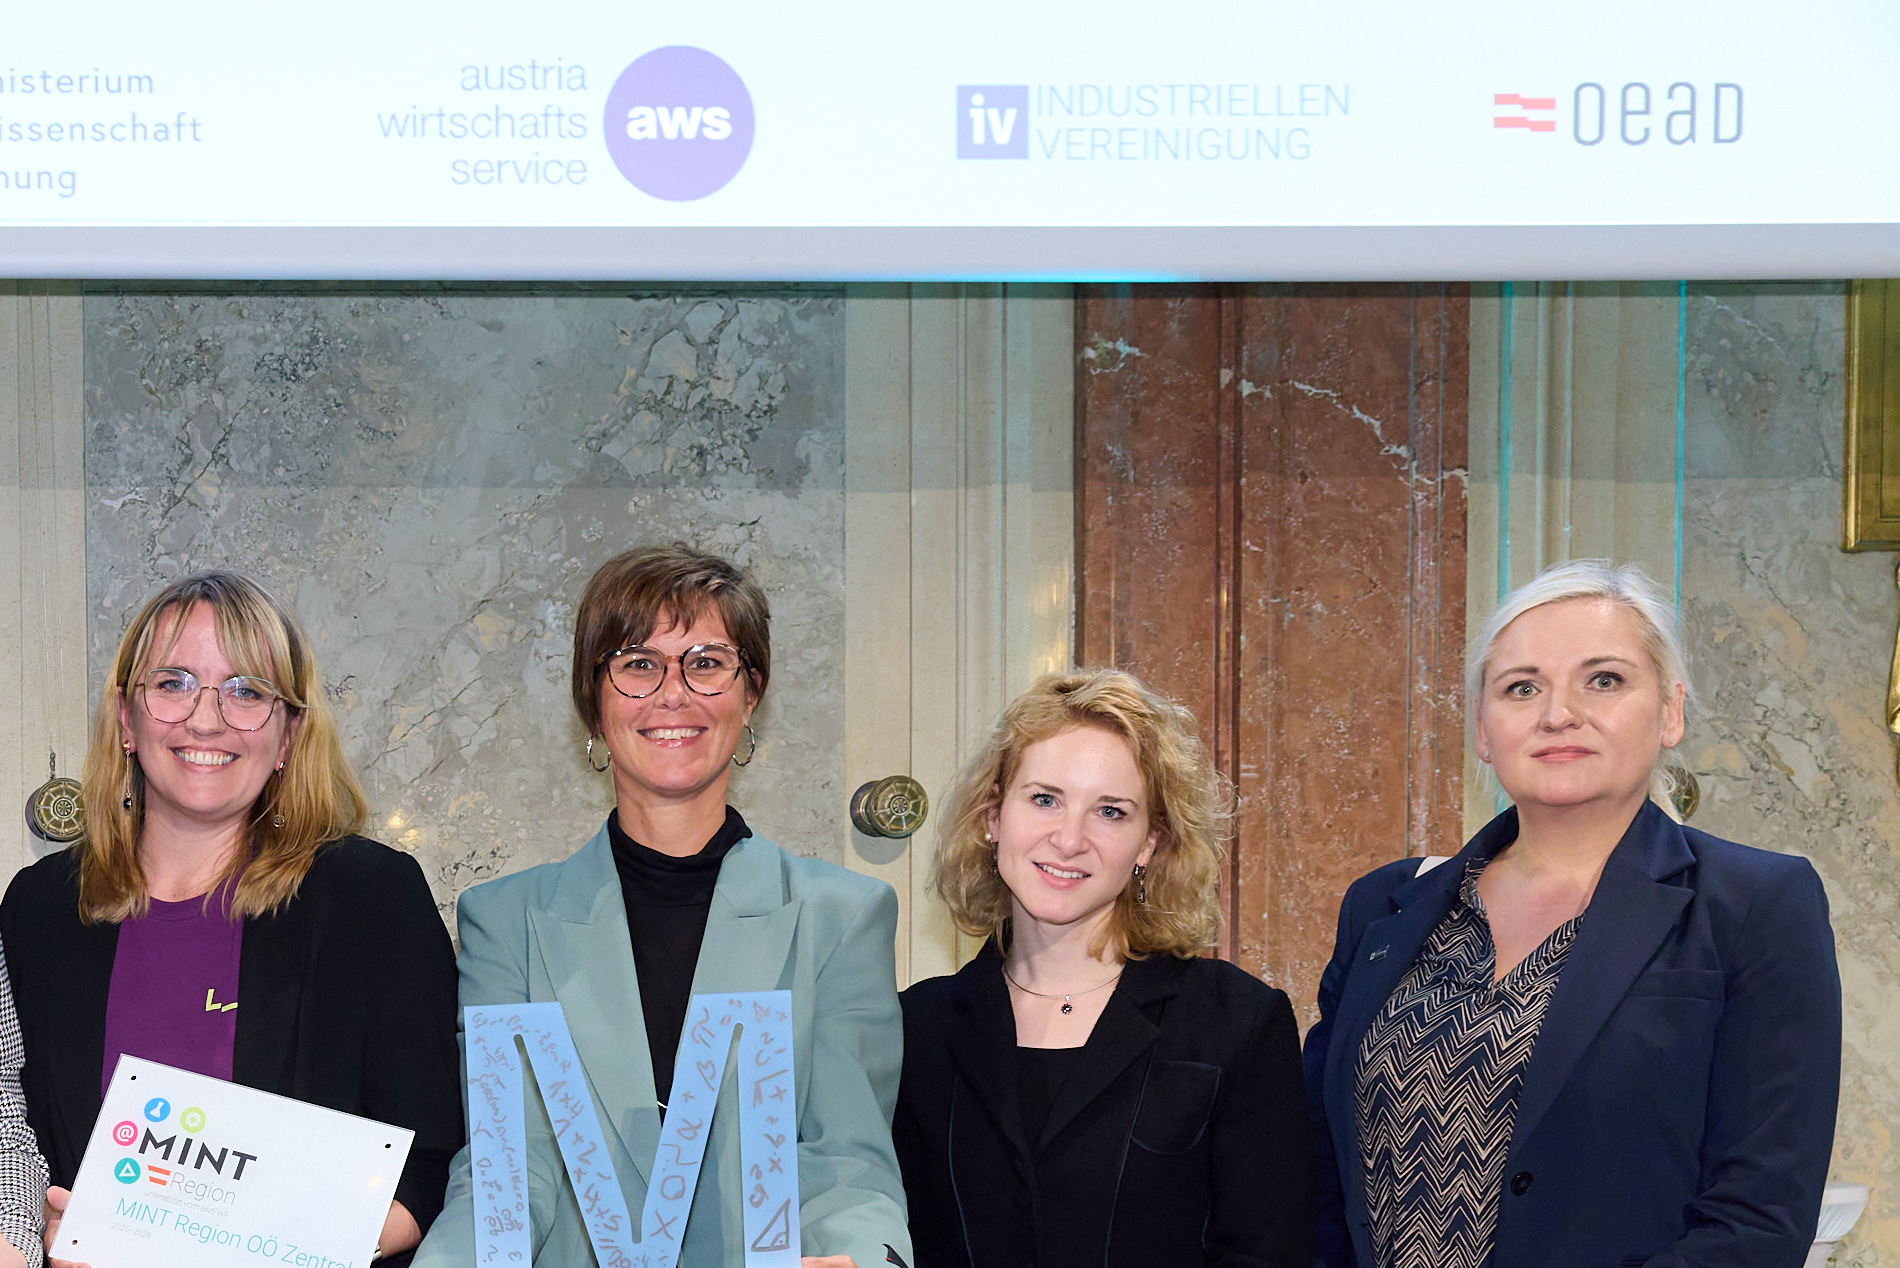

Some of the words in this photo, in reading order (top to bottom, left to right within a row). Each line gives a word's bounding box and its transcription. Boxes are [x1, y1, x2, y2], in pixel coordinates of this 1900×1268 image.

[459, 56, 590, 94] austria
[967, 93, 1019, 146] iv
[1035, 84, 1352, 120] INDUSTRIELLEN
[376, 104, 590, 141] wirtschafts
[625, 103, 733, 143] aws
[1035, 128, 1313, 163] VEREINIGUNG
[449, 151, 590, 188] service
[138, 1127, 257, 1181] MINT
[169, 1172, 236, 1206] Region
[116, 1198, 173, 1228] MINT
[174, 1213, 242, 1248] Region
[247, 1234, 280, 1258] OÖ
